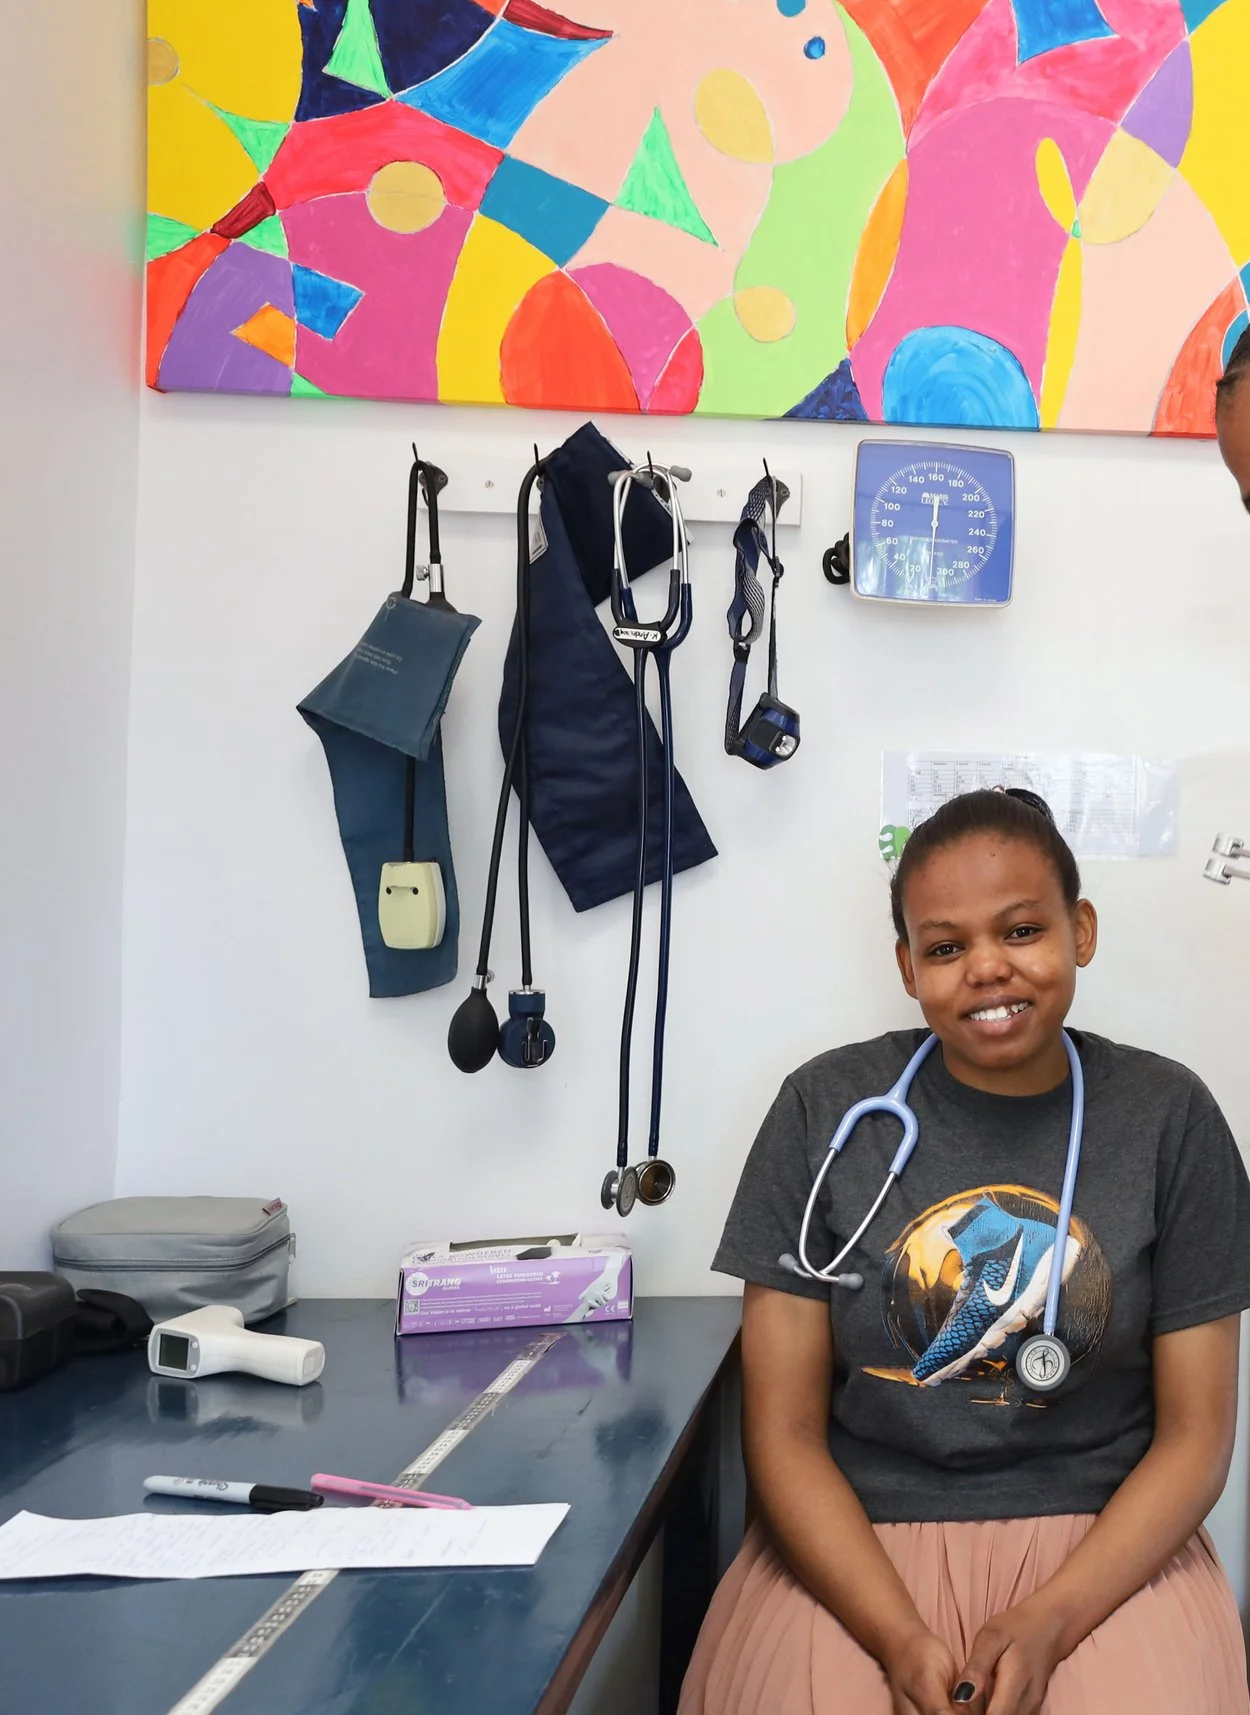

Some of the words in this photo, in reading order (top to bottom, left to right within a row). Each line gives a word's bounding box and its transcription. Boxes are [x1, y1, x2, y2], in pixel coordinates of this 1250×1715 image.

[909, 475, 925, 484] 140
[928, 473, 944, 482] 160
[948, 479, 964, 488] 180
[892, 486, 907, 494] 120
[962, 494, 980, 502] 200
[884, 503, 900, 511] 100
[968, 510, 985, 518] 220
[881, 519, 893, 527] 80
[968, 528, 986, 537] 240
[886, 537, 898, 545] 60
[967, 546, 985, 554] 260
[893, 553, 906, 561] 40
[909, 564, 921, 572] 20
[952, 561, 969, 569] 280
[936, 567, 954, 576] 300
[411, 1277, 462, 1289] SRITRANG
